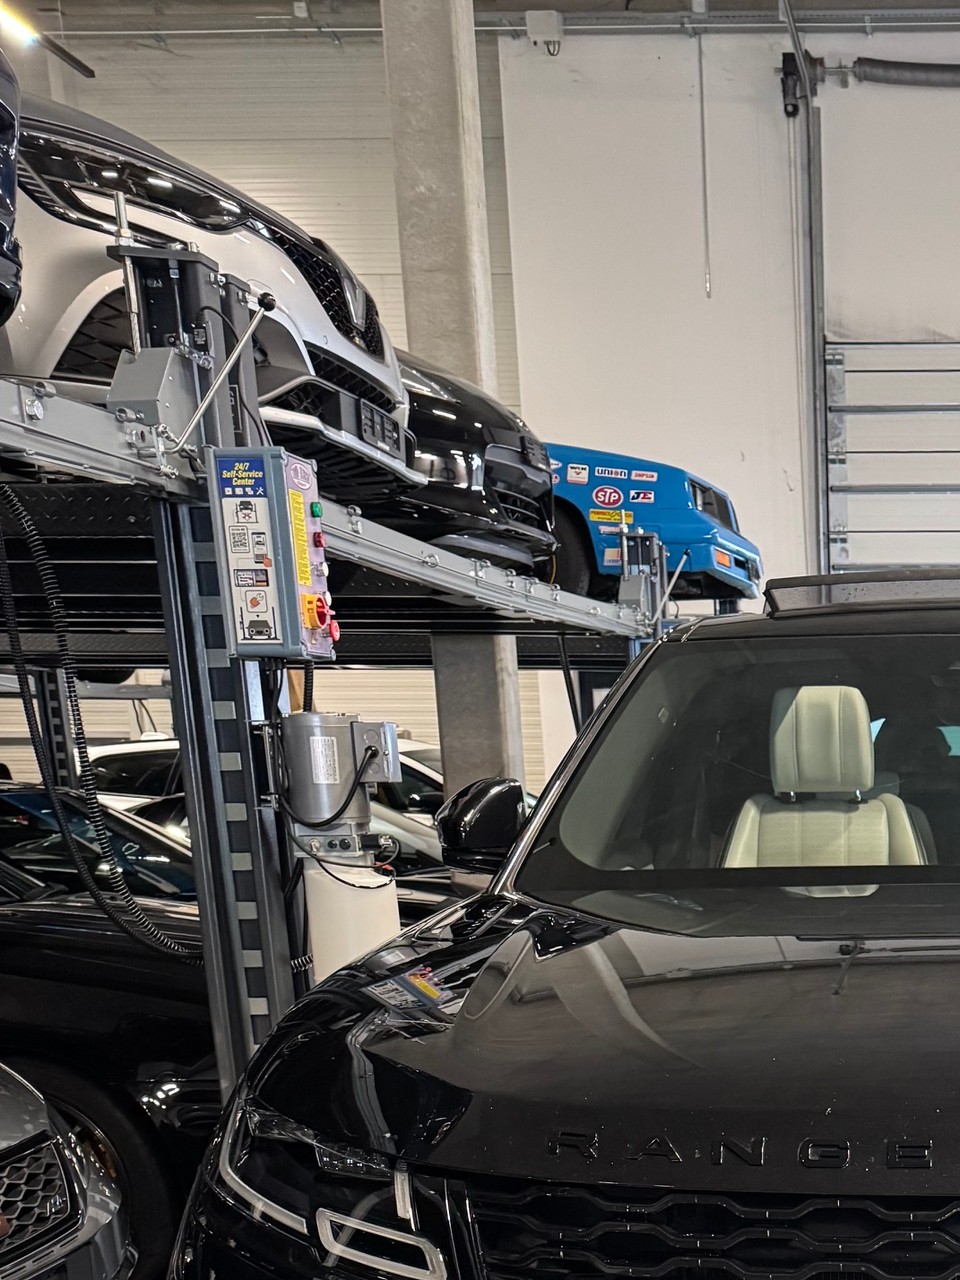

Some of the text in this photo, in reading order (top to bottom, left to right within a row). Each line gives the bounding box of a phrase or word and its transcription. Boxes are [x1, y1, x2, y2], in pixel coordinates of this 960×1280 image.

[222, 470, 263, 478] Self-Service
[597, 488, 619, 503] STP
[631, 491, 652, 500] JE
[547, 1131, 933, 1169] RANGE
